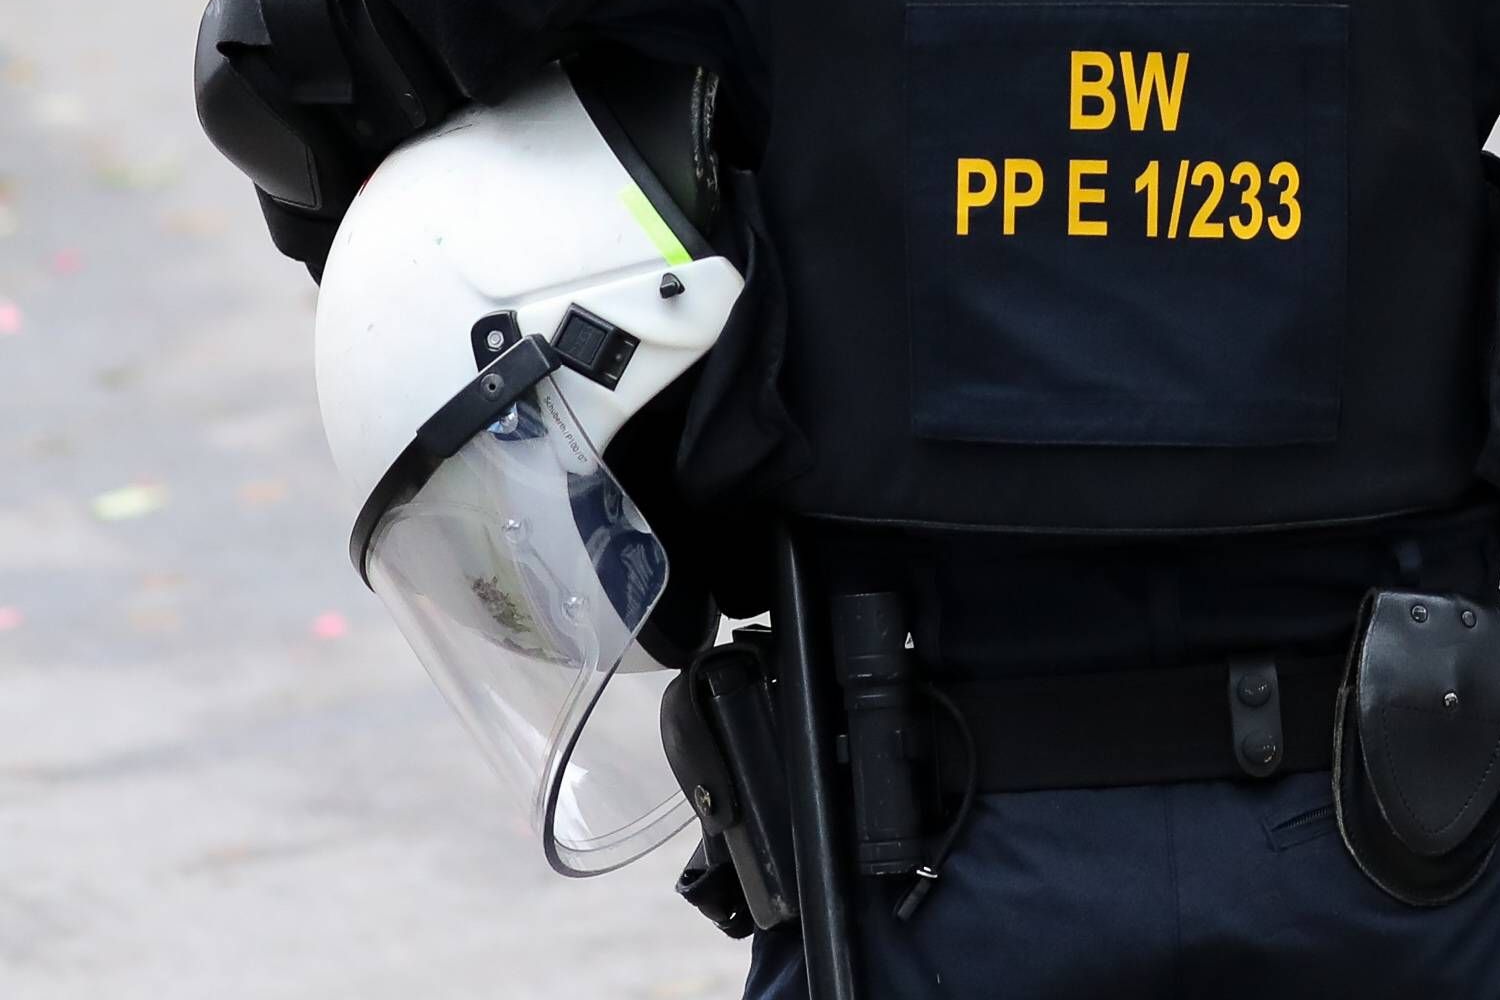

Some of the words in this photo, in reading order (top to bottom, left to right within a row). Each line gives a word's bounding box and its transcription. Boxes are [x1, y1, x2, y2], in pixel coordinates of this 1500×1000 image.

[1069, 50, 1190, 132] BW
[956, 157, 1044, 236] PP
[1067, 159, 1108, 237] E
[1134, 160, 1302, 241] 1/233
